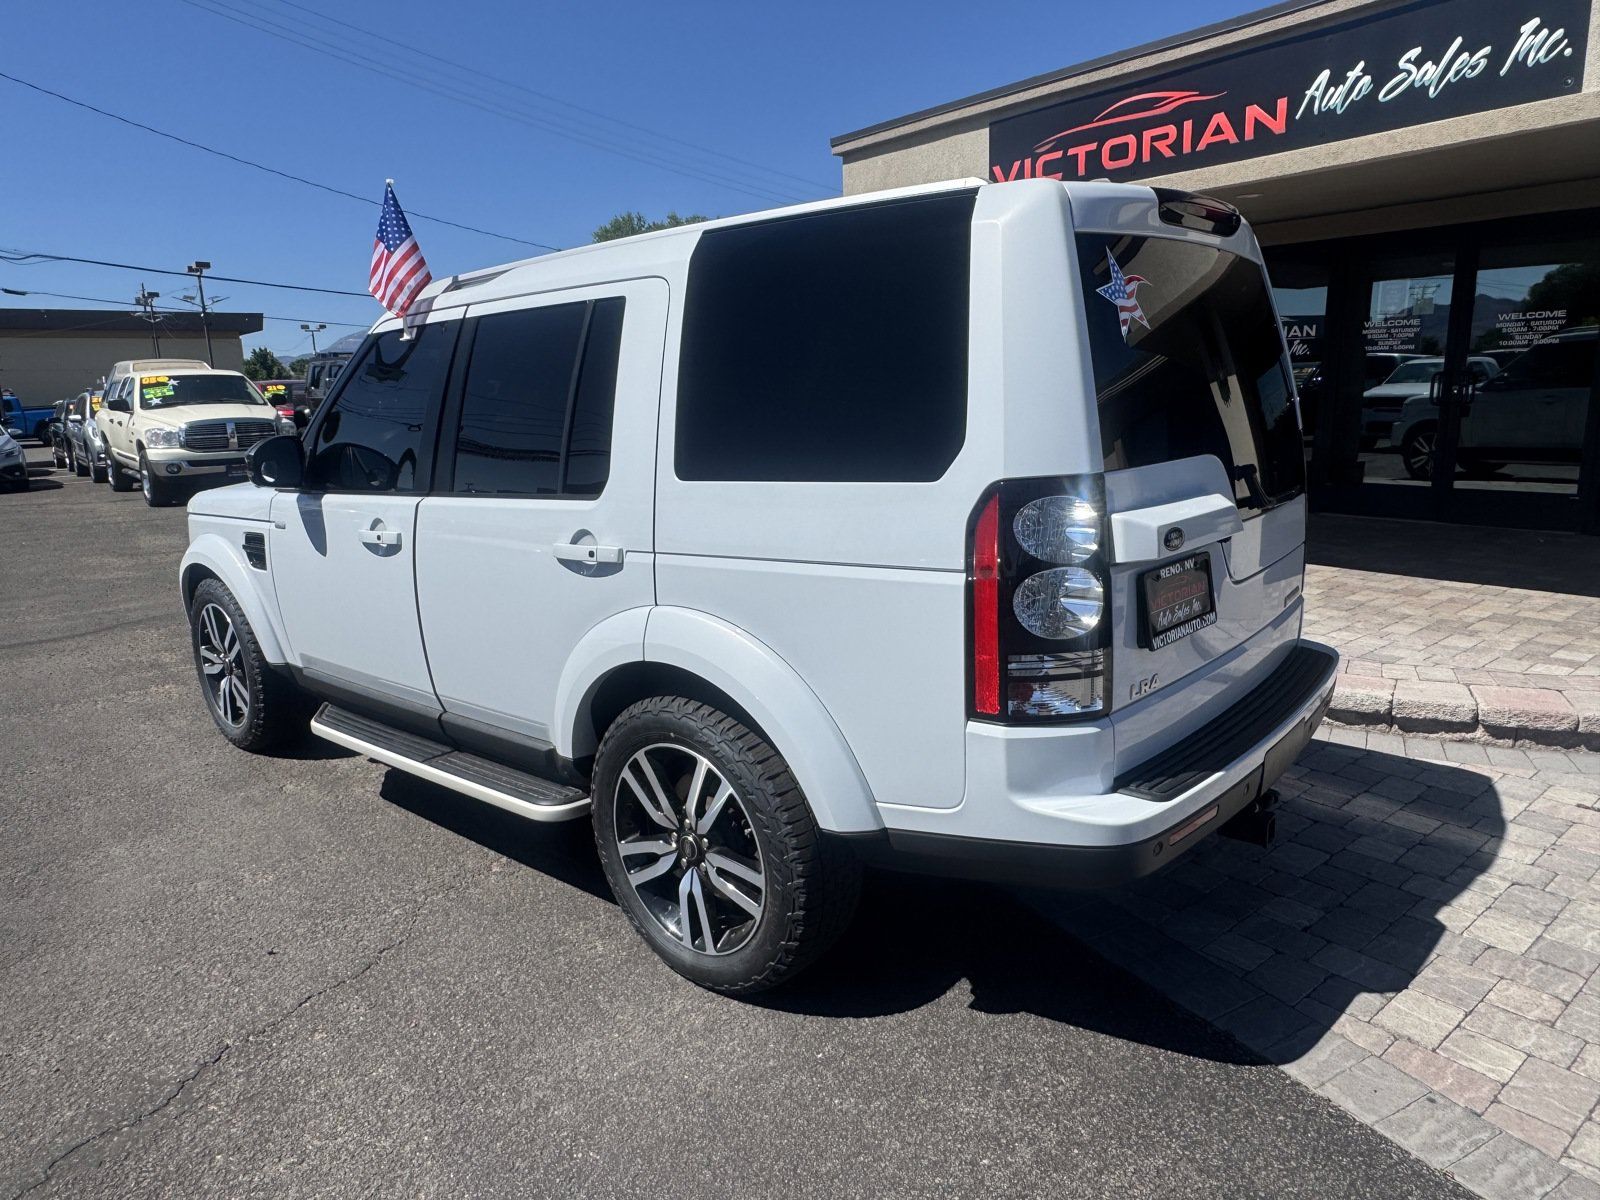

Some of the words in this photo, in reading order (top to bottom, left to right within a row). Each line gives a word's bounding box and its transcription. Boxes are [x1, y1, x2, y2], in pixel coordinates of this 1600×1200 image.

[992, 97, 1288, 182] VICTORIAN
[1296, 60, 1373, 120] Auto
[1378, 36, 1491, 102] Sales
[1500, 17, 1572, 76] Inc.
[1364, 318, 1421, 327] WELCOME
[1498, 310, 1567, 320] WELCOME
[1160, 563, 1183, 578] RENO,
[1184, 558, 1195, 570] NV
[1151, 581, 1206, 609] VICTORIAN
[1157, 609, 1172, 629] Auto
[1173, 602, 1190, 622] Sales
[1152, 611, 1217, 650] VICTORIANAUTO.COM
[1129, 672, 1161, 701] LR4
